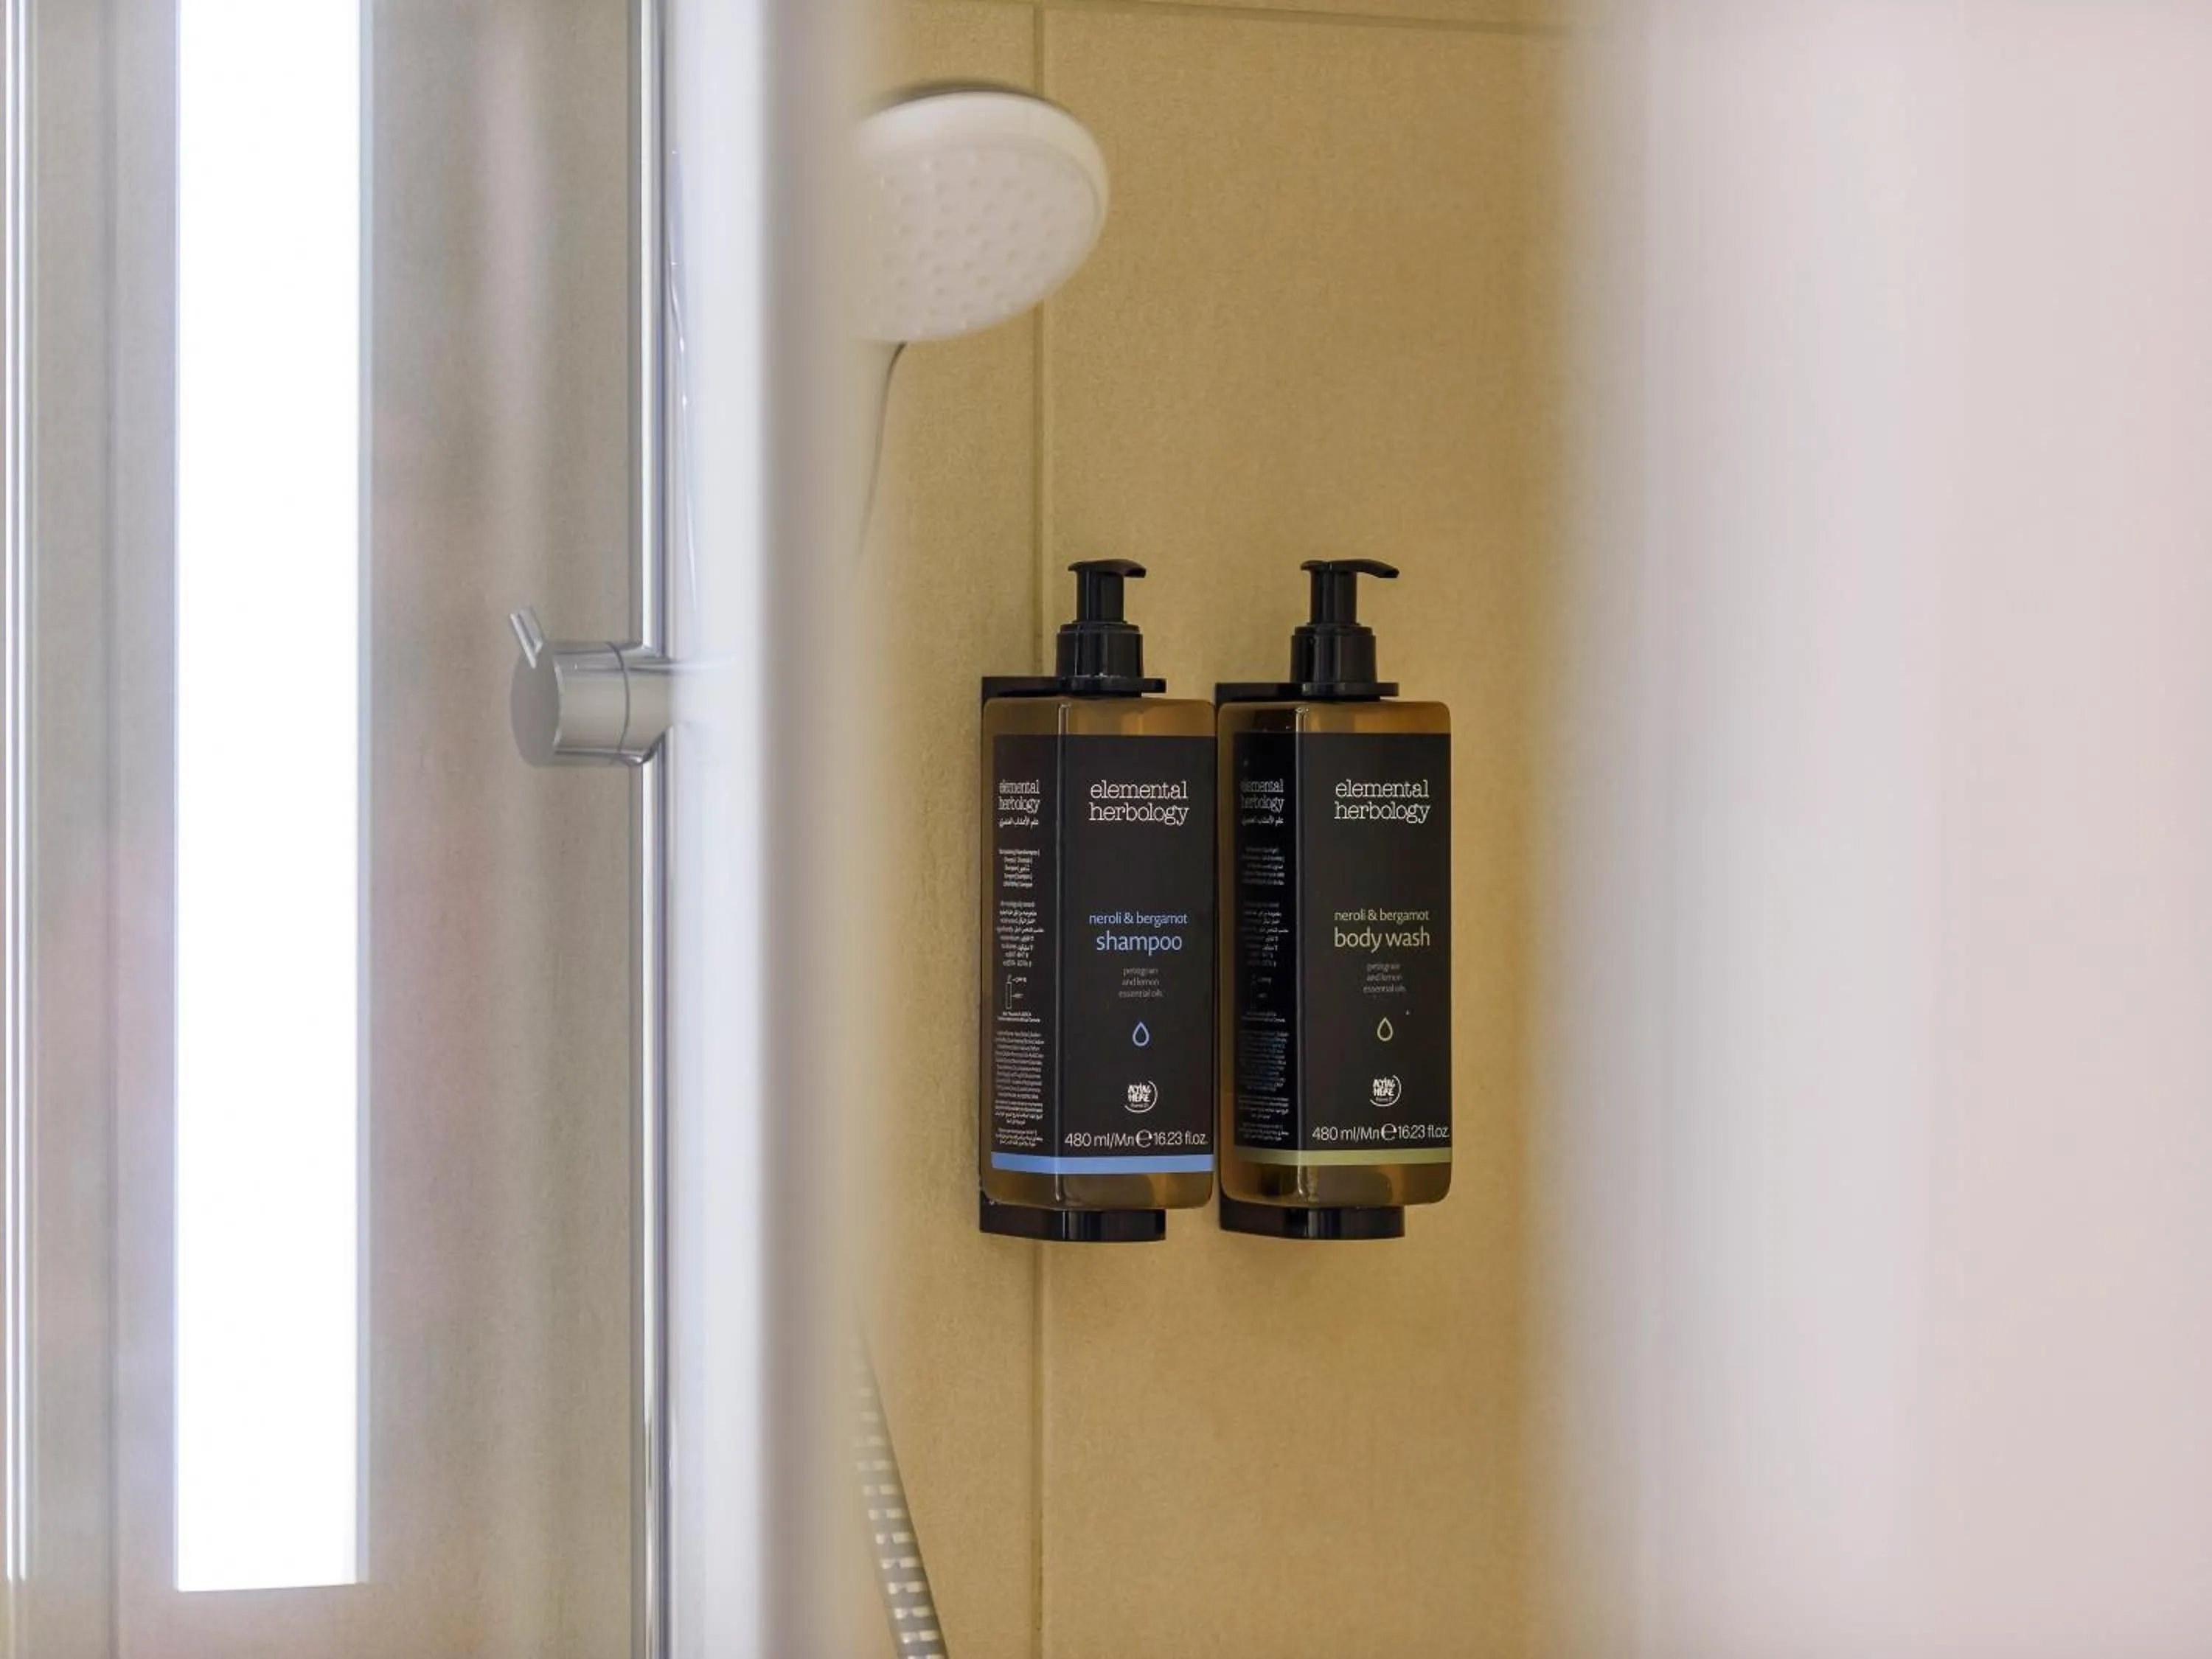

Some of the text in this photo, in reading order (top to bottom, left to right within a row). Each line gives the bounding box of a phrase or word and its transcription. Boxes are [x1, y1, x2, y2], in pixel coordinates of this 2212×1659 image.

[1091, 779, 1189, 799] elemental
[1335, 779, 1430, 798] elemental
[1088, 801, 1190, 826] herbology
[1334, 801, 1431, 824] herbology
[1089, 911, 1188, 928] neroli & bergamot
[1335, 908, 1430, 925] neroli & bergamot
[1096, 930, 1183, 956] shampoo
[1334, 925, 1430, 953] body wash
[1064, 1133, 1092, 1147] 480
[1312, 1126, 1338, 1141] 480
